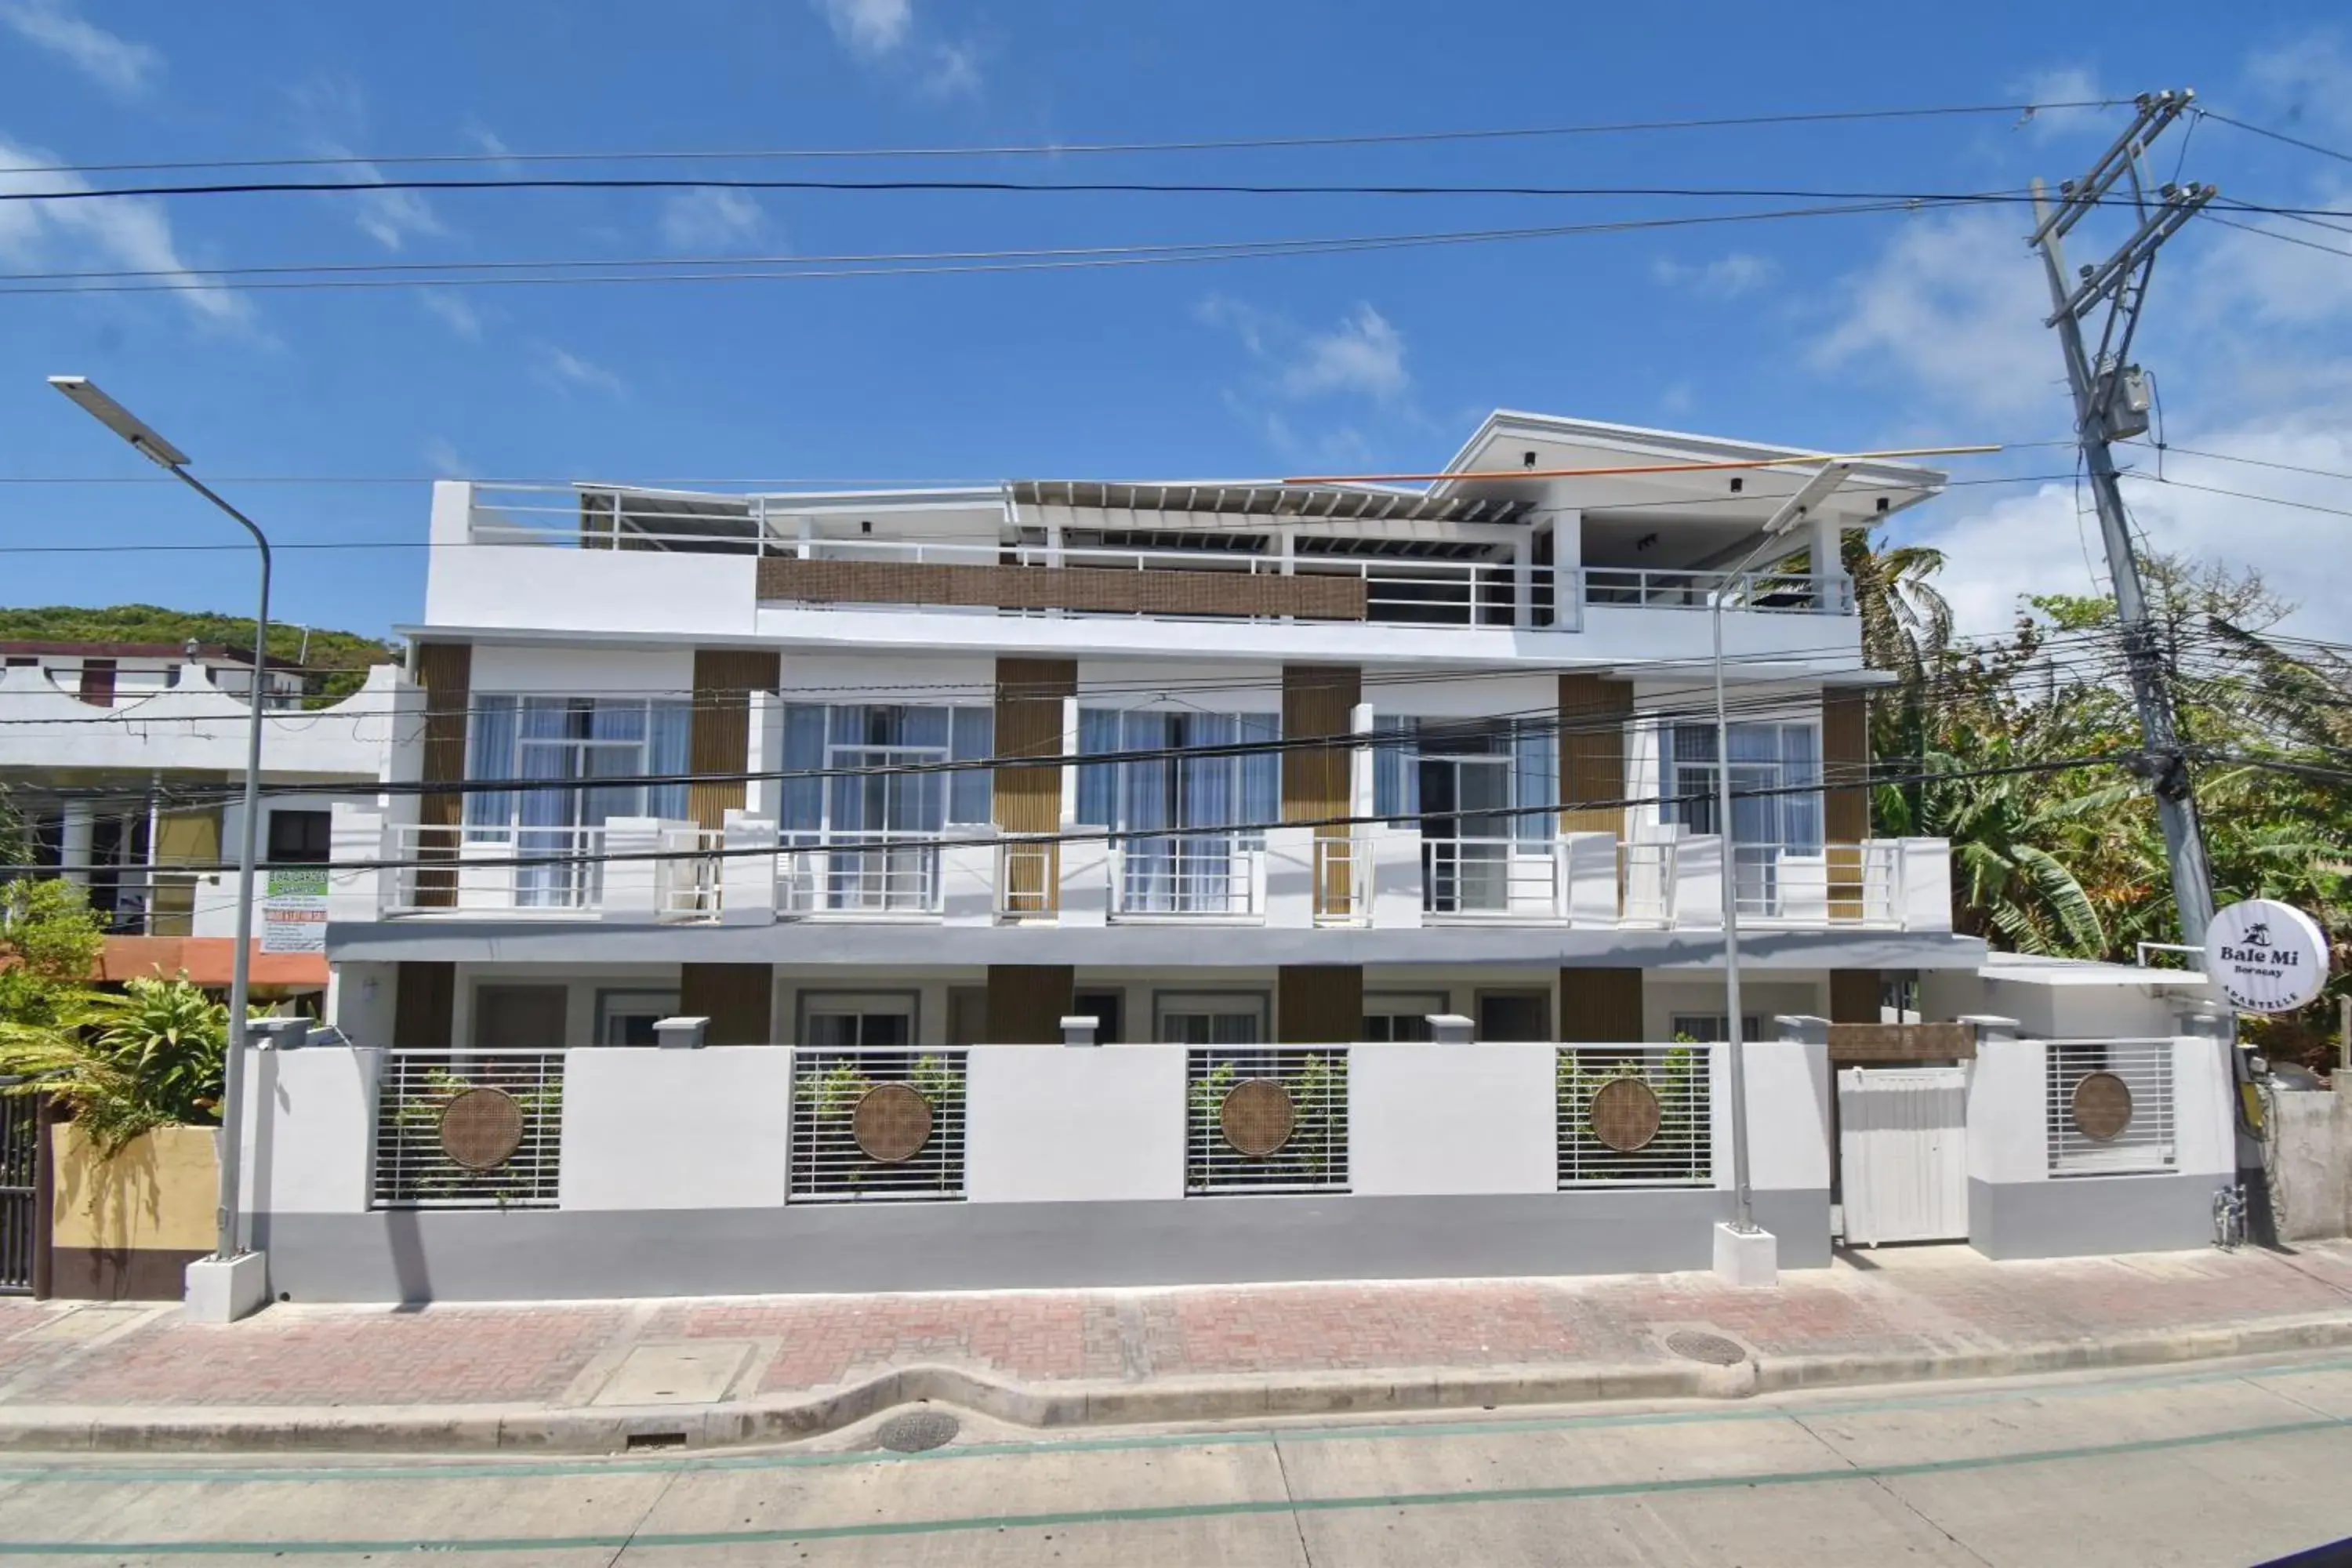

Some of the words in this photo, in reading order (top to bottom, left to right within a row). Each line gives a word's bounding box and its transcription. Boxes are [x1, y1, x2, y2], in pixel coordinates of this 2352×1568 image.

[2220, 946, 2266, 963] Bale
[2270, 949, 2299, 966] Mi
[2234, 965, 2284, 978] Boracay
[2223, 985, 2298, 1009] APARTELLE
